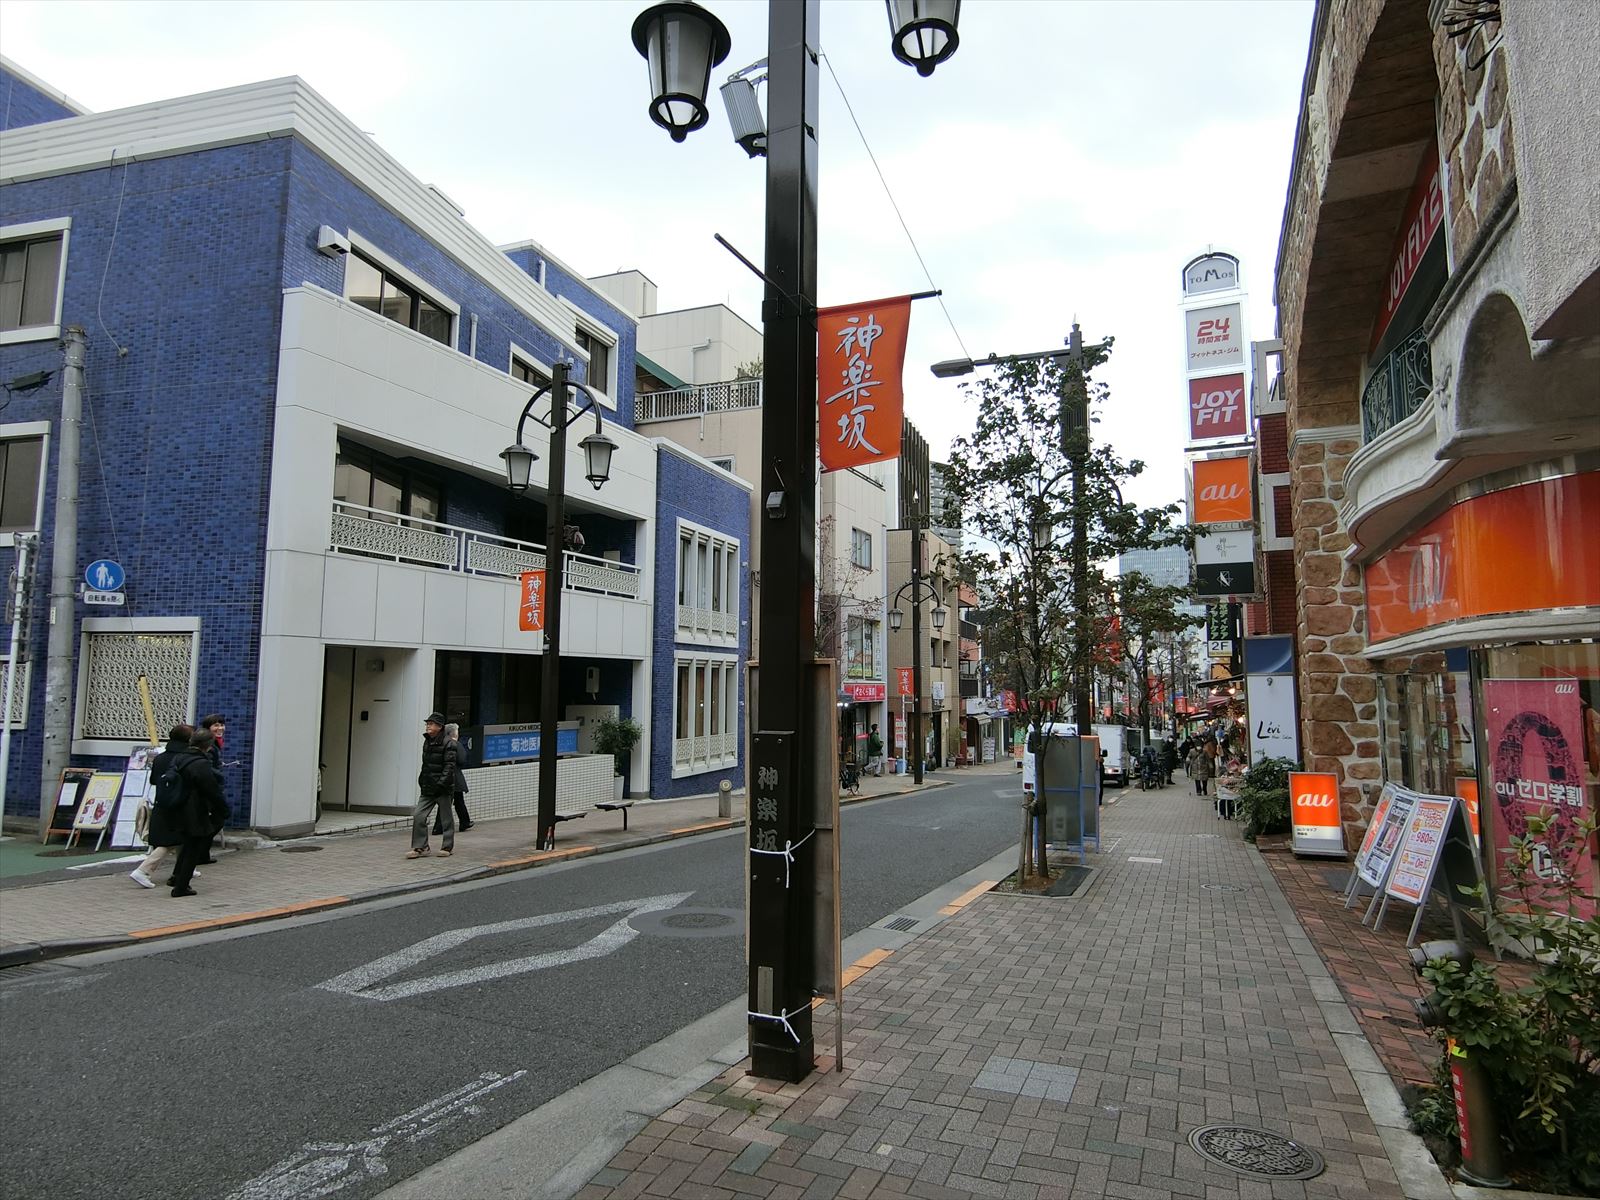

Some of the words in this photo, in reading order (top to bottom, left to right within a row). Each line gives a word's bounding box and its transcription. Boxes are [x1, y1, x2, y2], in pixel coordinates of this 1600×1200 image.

[1190, 269, 1234, 285] TOMOS
[1196, 317, 1231, 337] 24
[1197, 333, 1230, 345] 時間営業
[1190, 347, 1239, 359] フィットネス・ジム
[825, 313, 884, 455] 神楽坂
[1192, 388, 1242, 410] JOY
[1195, 405, 1238, 426] FIT
[1200, 482, 1246, 501] au
[1408, 544, 1449, 613] au
[522, 575, 542, 628] 神楽坂
[1211, 641, 1229, 651] 2F
[1554, 682, 1575, 694] au
[756, 766, 779, 852] 神楽坂
[1296, 792, 1334, 808] au
